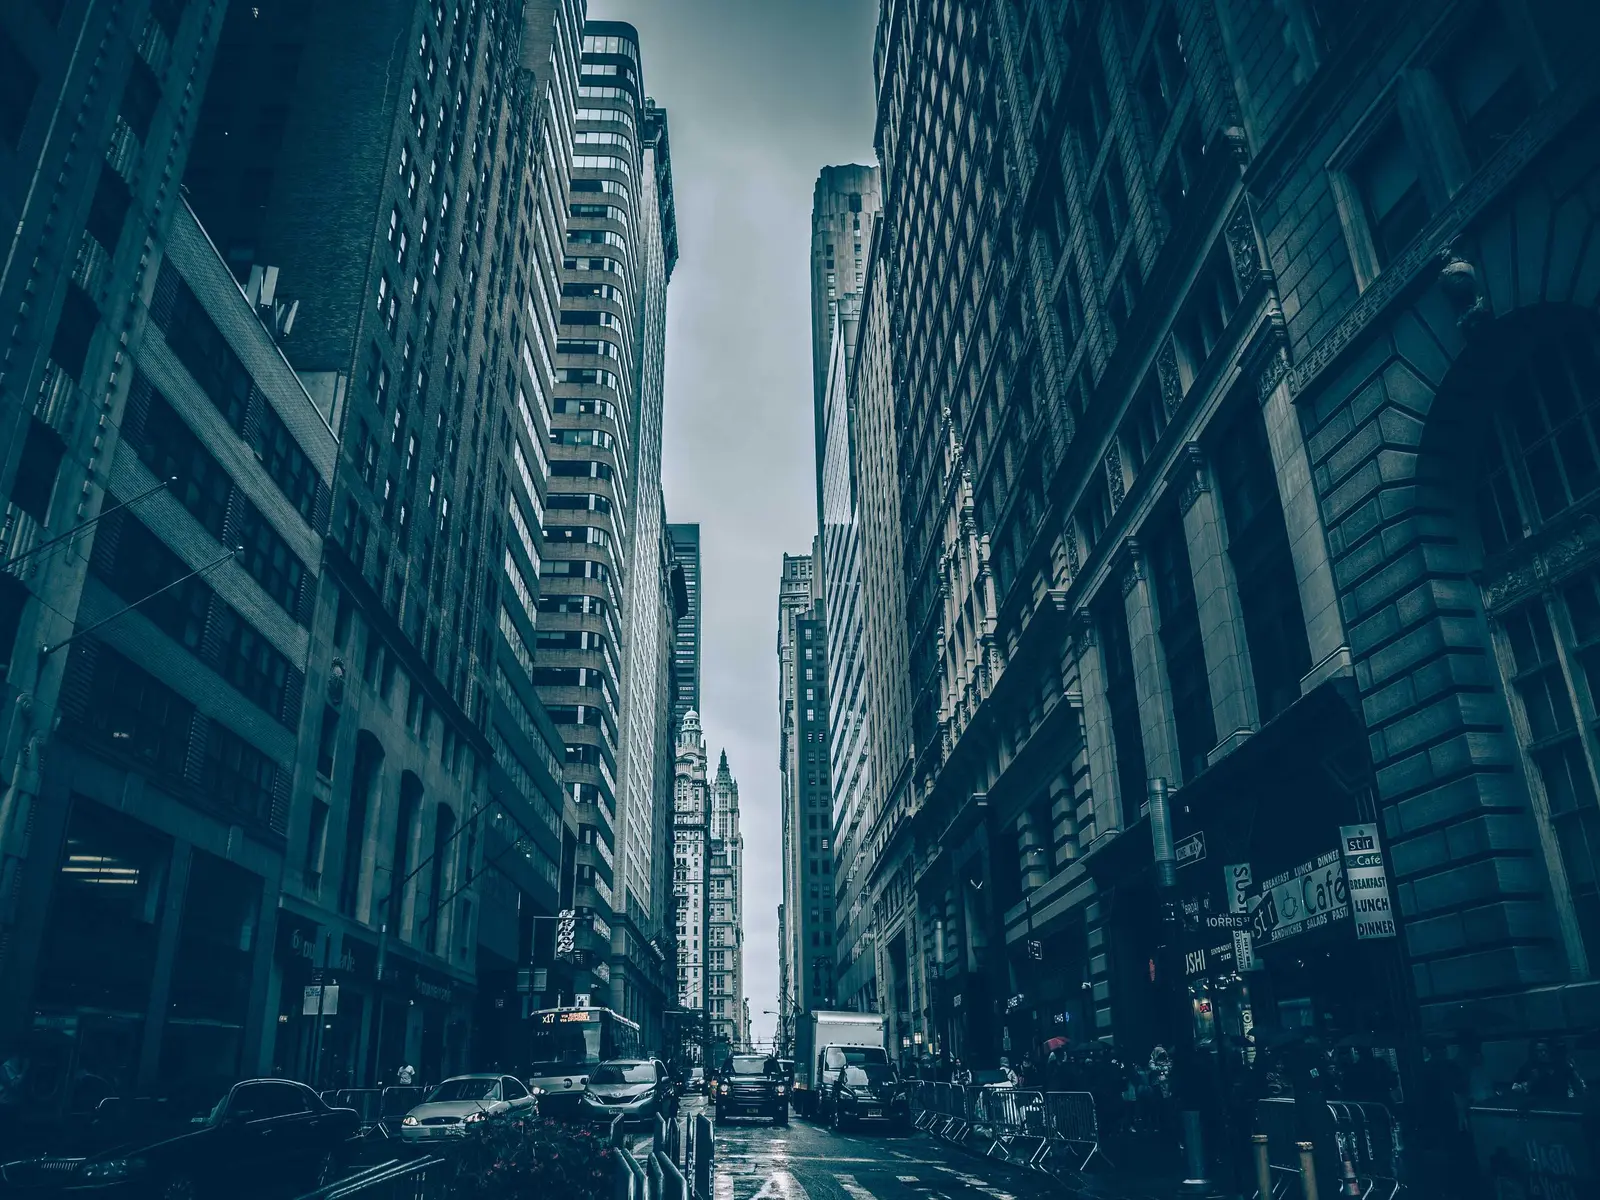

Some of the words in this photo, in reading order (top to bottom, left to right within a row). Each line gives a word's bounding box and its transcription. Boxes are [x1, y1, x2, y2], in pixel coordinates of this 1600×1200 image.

[1356, 855, 1381, 866] Café
[1262, 871, 1289, 891] BREAKFAST
[1294, 861, 1312, 877] LUNCH
[1317, 849, 1340, 867] DINNER
[1350, 876, 1385, 890] BREAKFAST
[1303, 869, 1347, 915] Café
[1355, 897, 1388, 912] LUNCH
[1271, 922, 1302, 941] SANDWICHES
[1306, 913, 1328, 929] SALADS
[1358, 920, 1394, 936] DINNER
